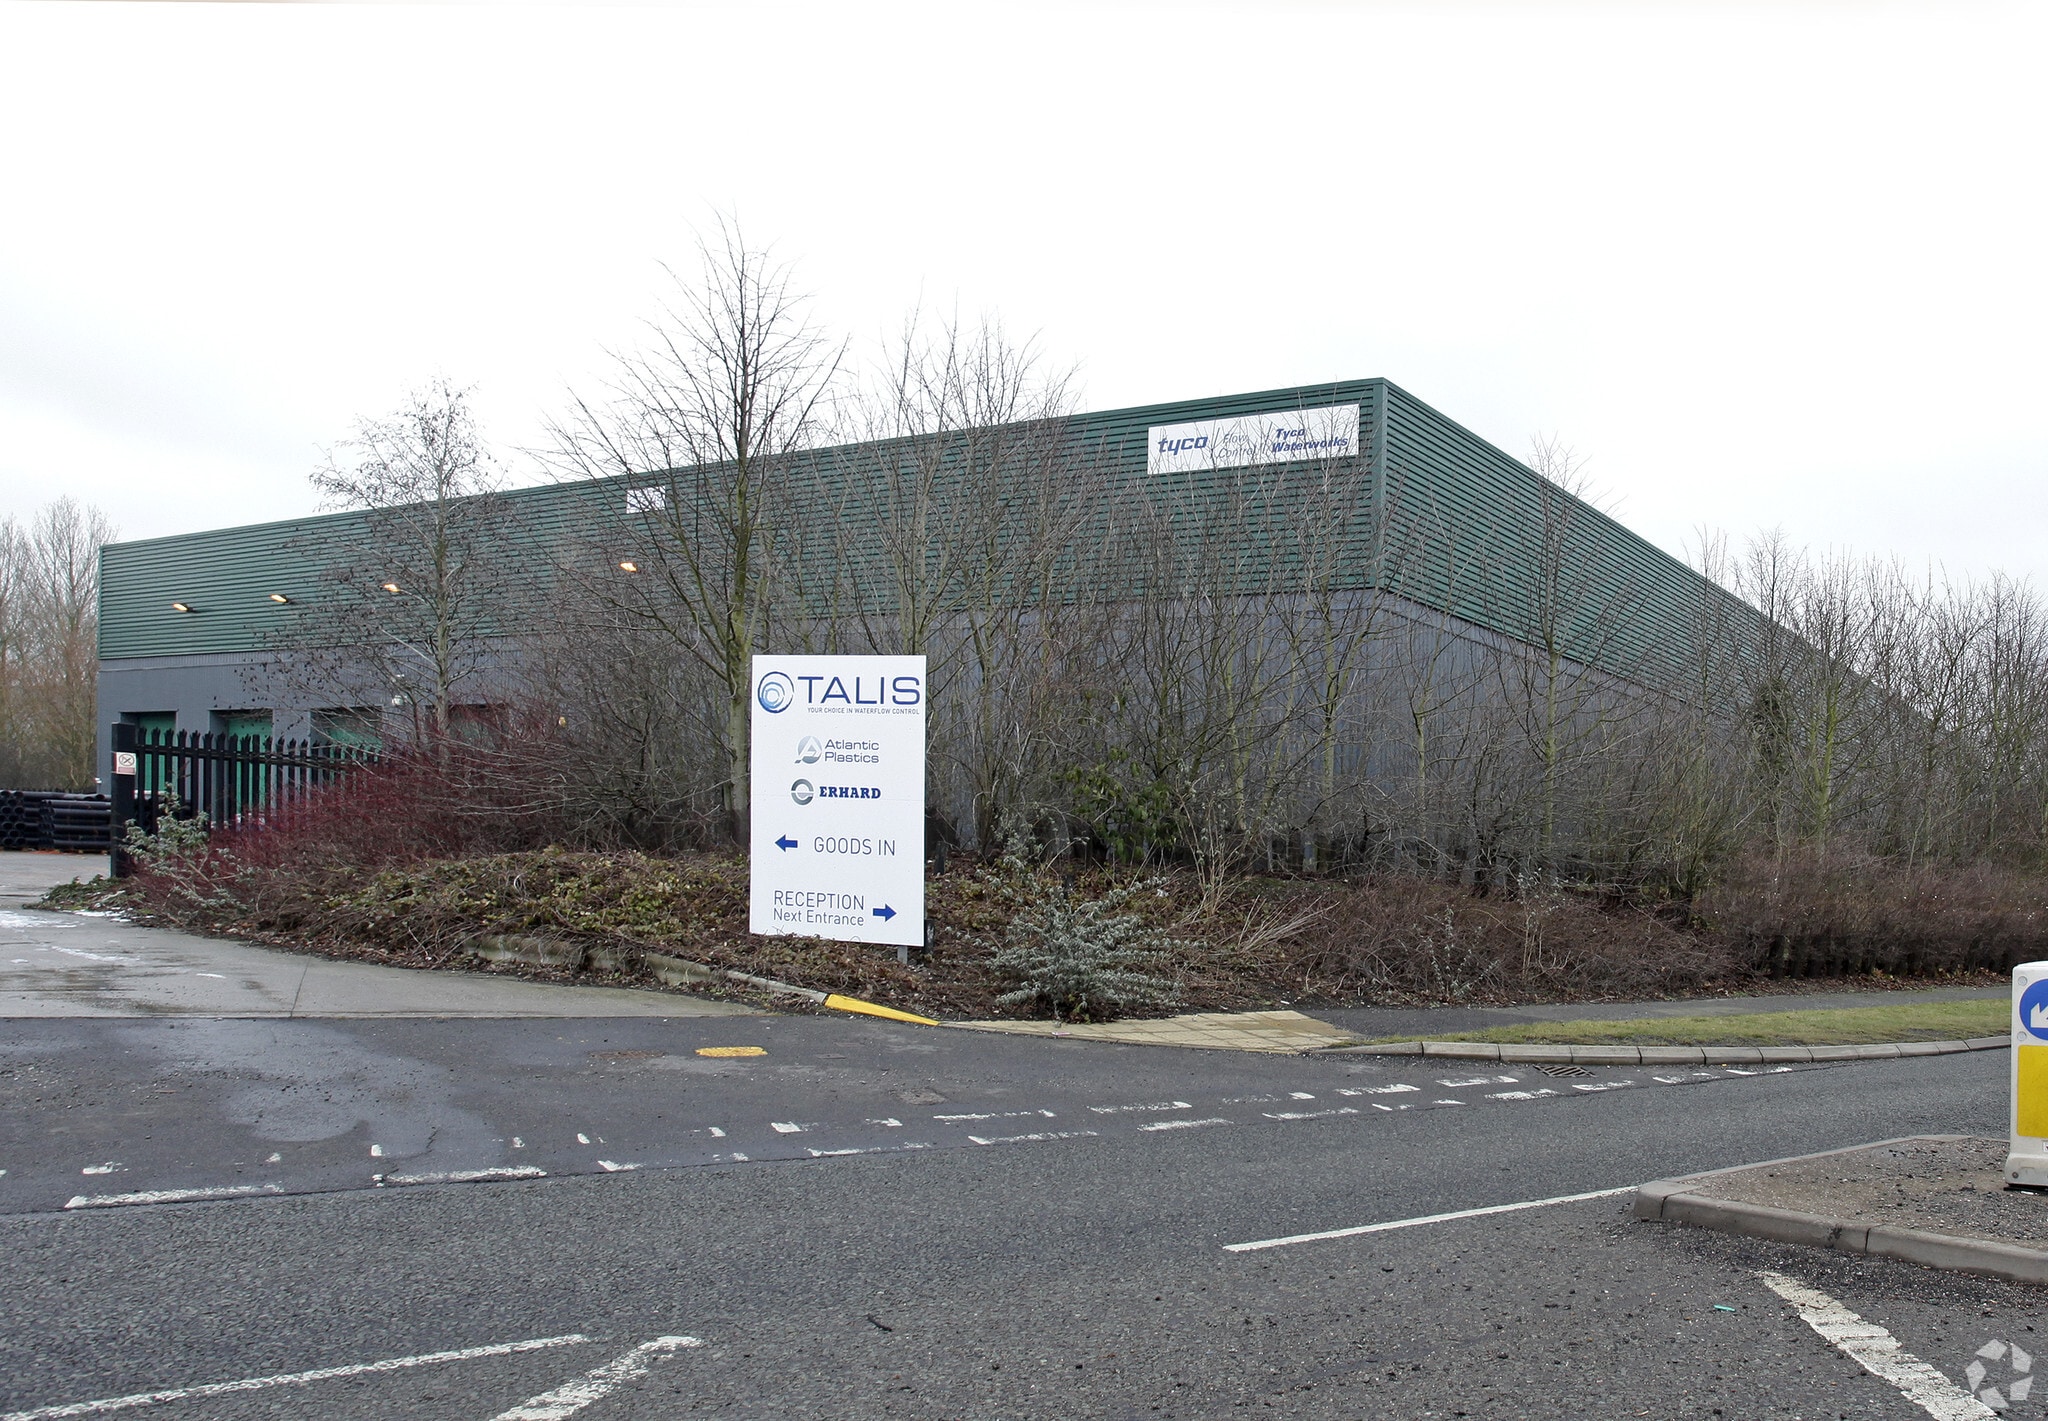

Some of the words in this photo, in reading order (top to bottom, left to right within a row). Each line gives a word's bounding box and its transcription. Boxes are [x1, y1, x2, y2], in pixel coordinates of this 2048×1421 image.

[1276, 428, 1305, 440] Tyco
[1158, 436, 1208, 455] tyco
[1272, 437, 1348, 453] Waterworks
[797, 676, 921, 705] TALIS
[824, 739, 880, 750] Atlantic
[824, 752, 880, 763] Plastics
[819, 786, 881, 799] ERHARD
[814, 836, 872, 855] GOODS
[878, 839, 896, 856] IN
[774, 890, 865, 910] RECEPTION
[773, 907, 802, 923] Next
[806, 909, 864, 926] Entrance
